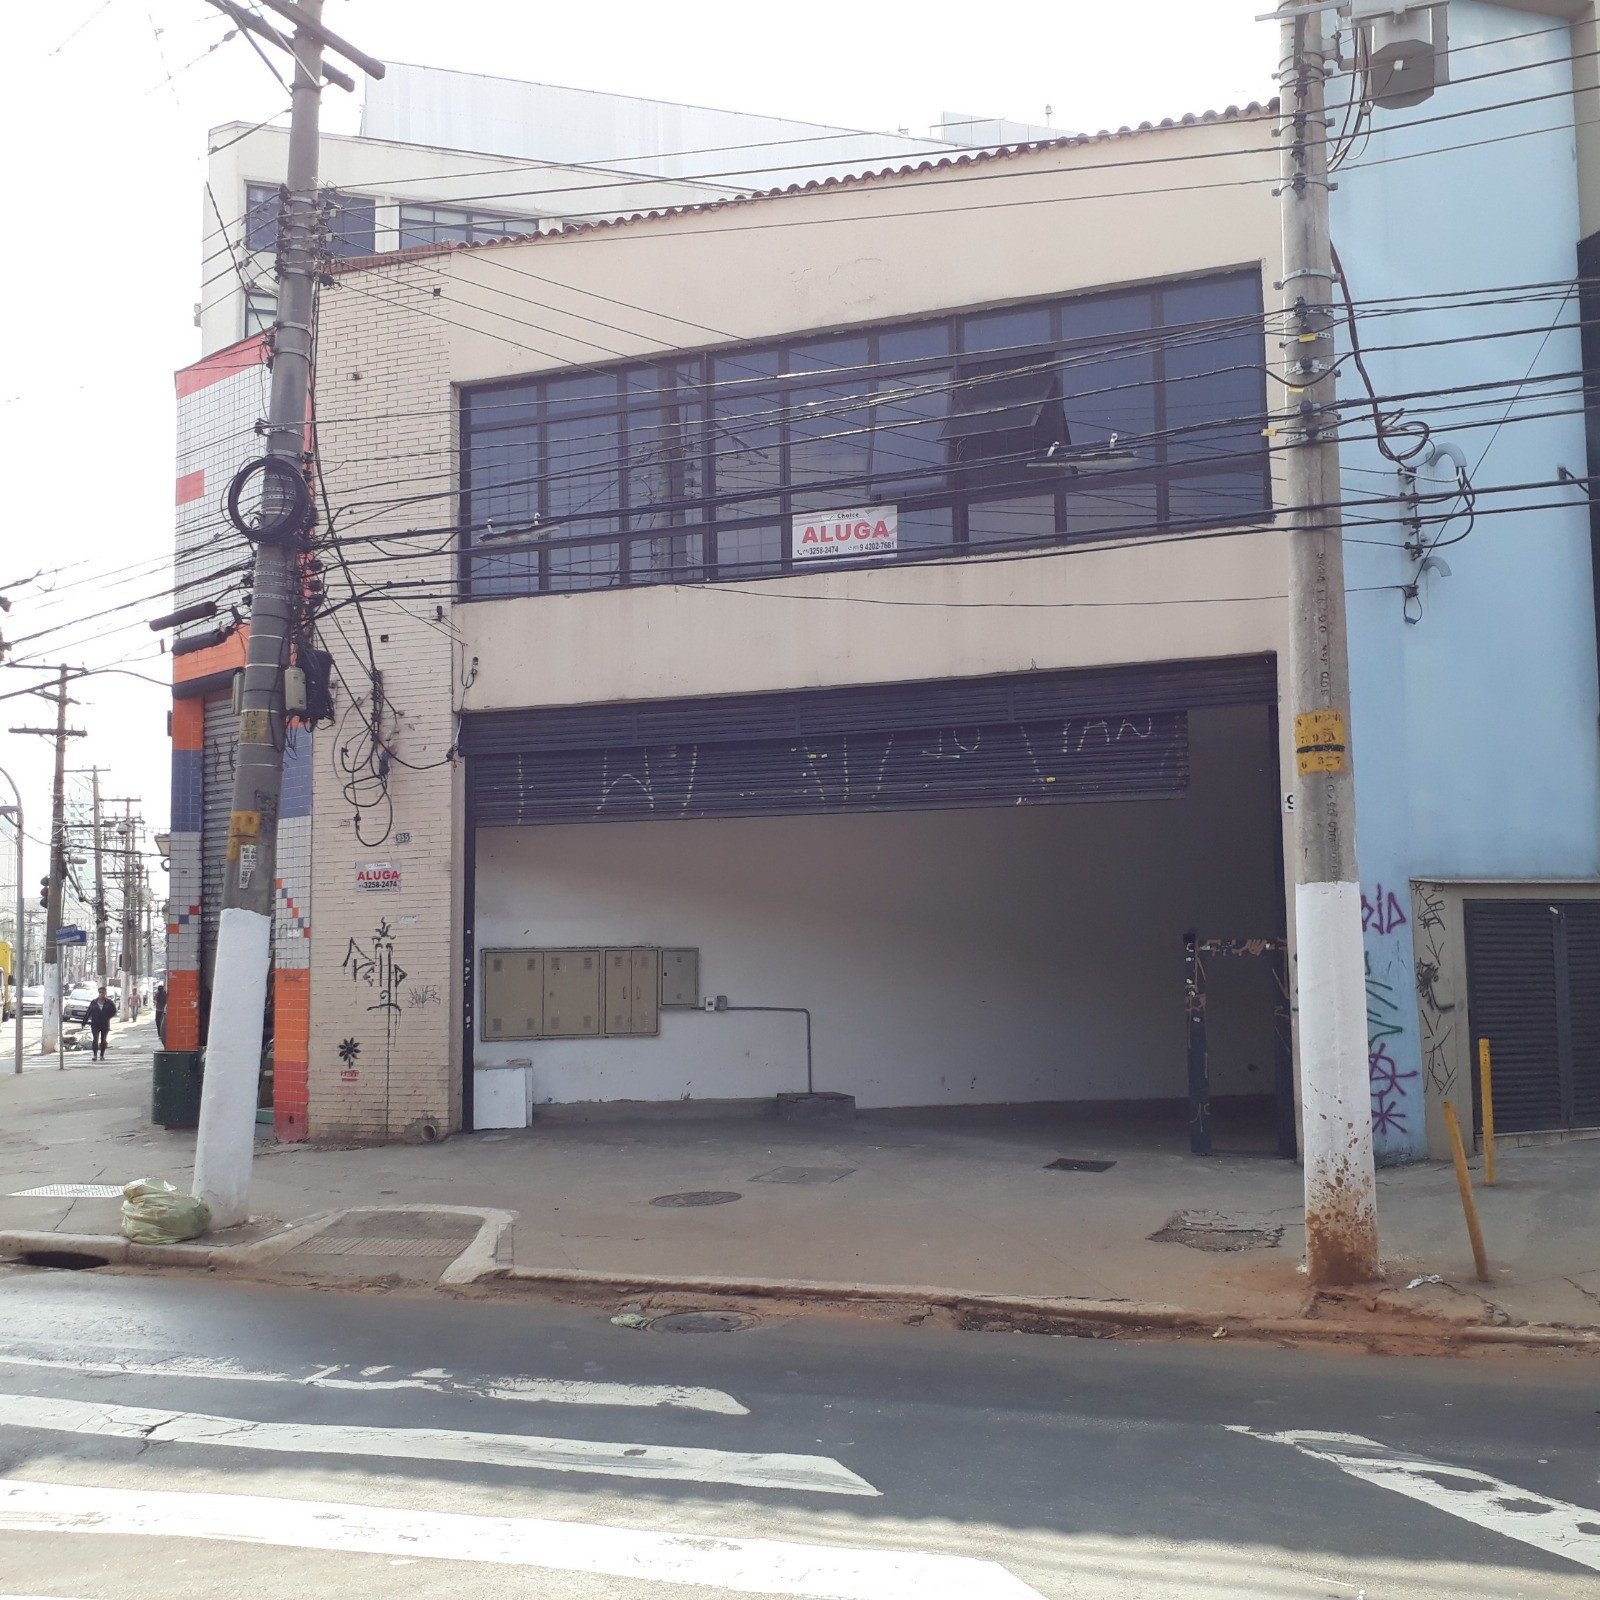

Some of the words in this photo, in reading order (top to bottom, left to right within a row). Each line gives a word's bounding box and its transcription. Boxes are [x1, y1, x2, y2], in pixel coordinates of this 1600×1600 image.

[802, 520, 890, 544] ALUGA
[357, 870, 400, 881] ALUGA
[364, 881, 397, 889] 3258-2474
